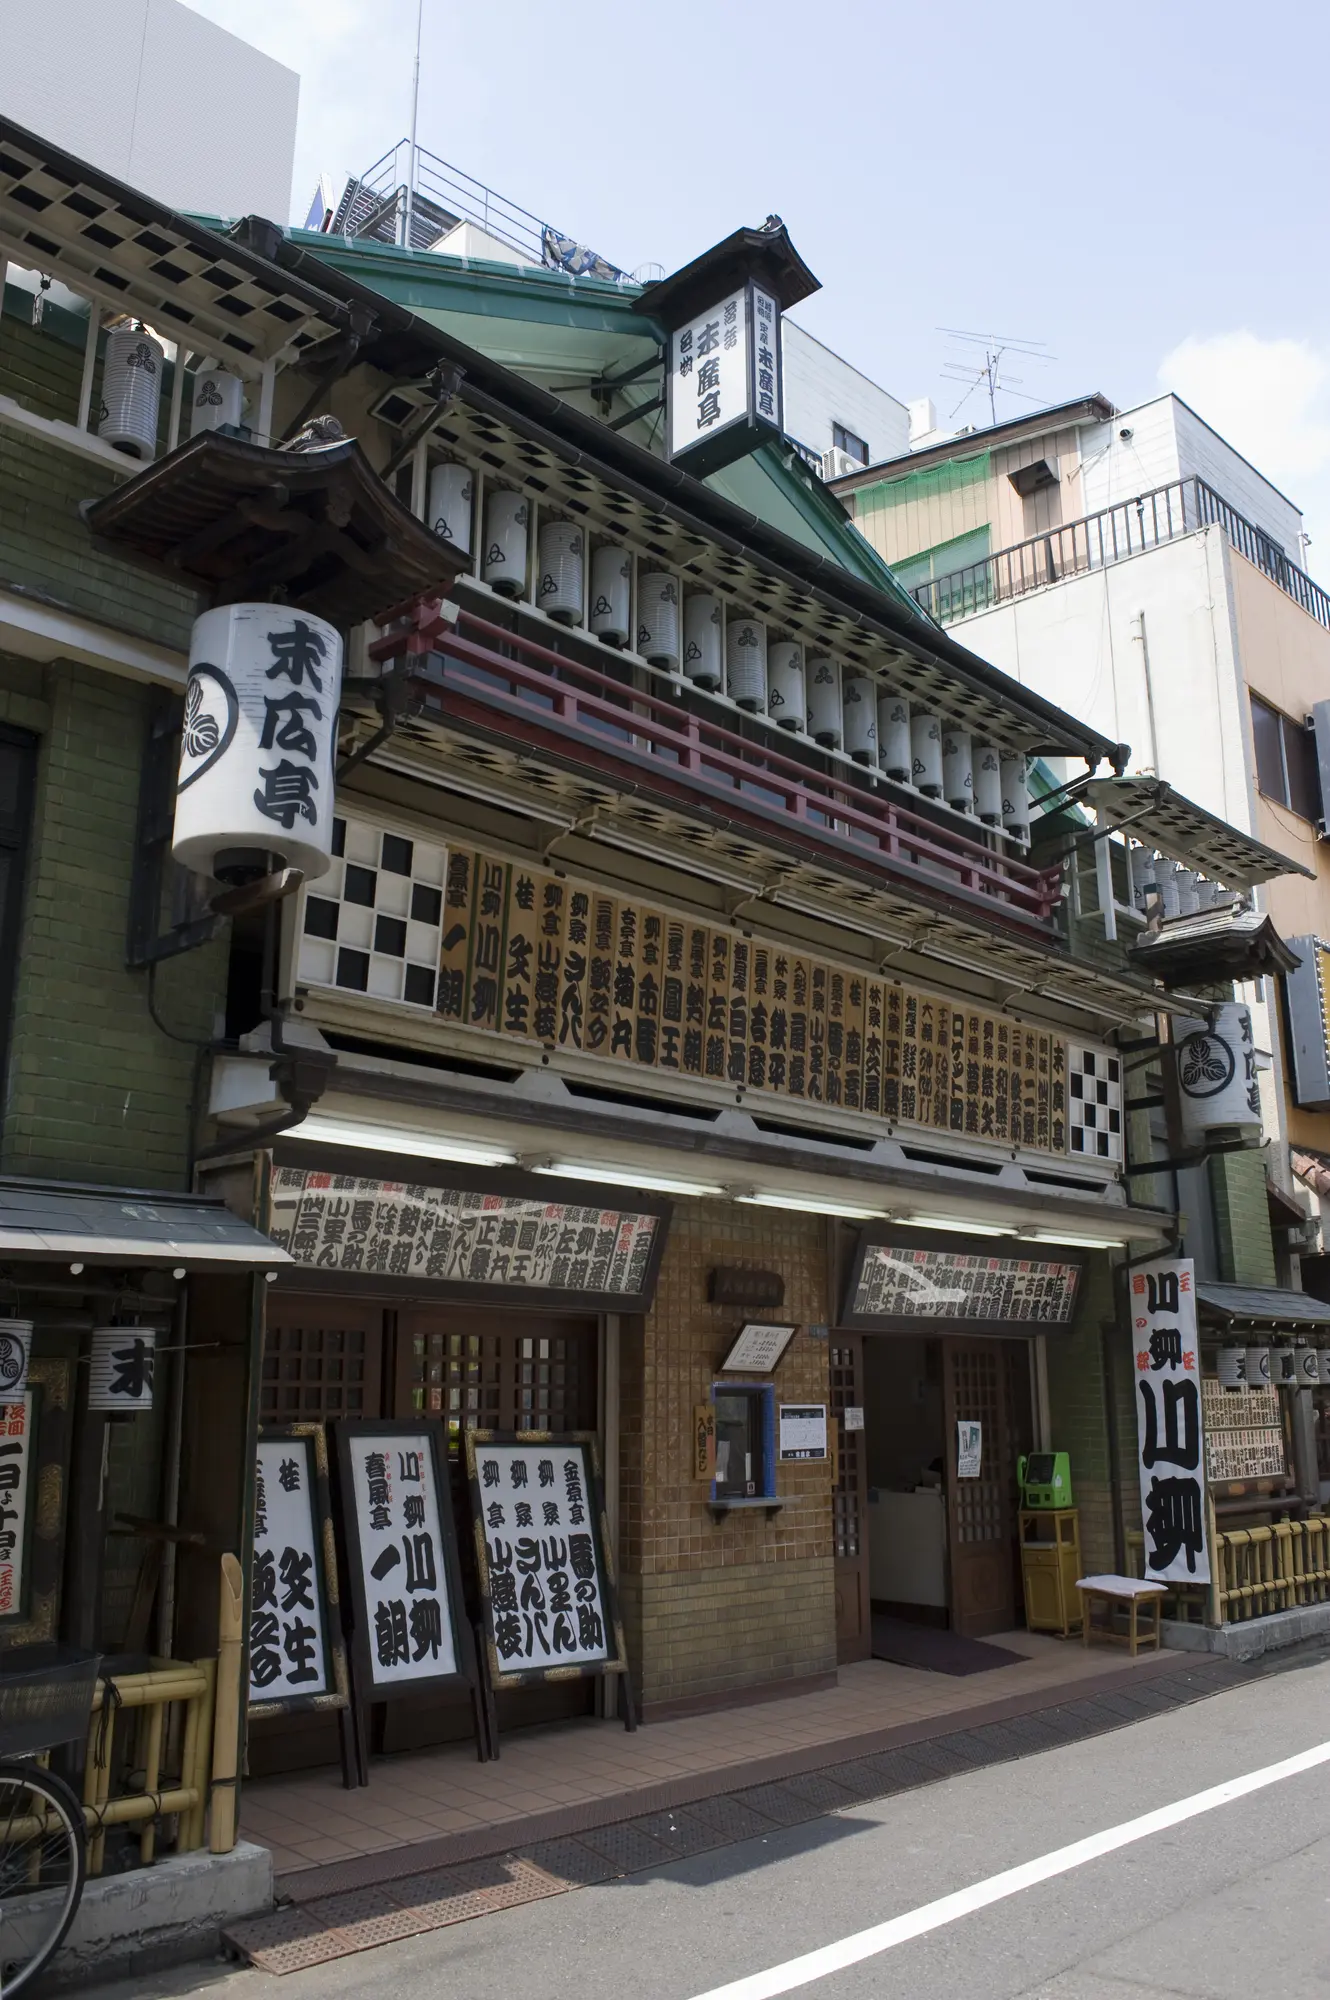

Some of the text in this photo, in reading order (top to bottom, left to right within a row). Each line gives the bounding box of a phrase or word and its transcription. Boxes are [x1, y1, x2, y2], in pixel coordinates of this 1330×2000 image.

[696, 321, 721, 430] 末廣亭
[758, 345, 774, 417] 末廣亭
[253, 619, 327, 830] 末広亭
[437, 852, 470, 1018] 春風亭一朝
[505, 873, 535, 1033] 桂文生
[636, 914, 660, 1063] 柳亭市馬
[949, 1012, 965, 1132] ロケット団
[317, 1196, 350, 1267] 小里ん
[341, 1199, 374, 1270] 馬の助
[109, 1338, 154, 1398] 末
[278, 1456, 319, 1686] 桂文生
[364, 1450, 410, 1668] 春風亭一朝
[397, 1450, 443, 1661] 川柳川柳
[538, 1459, 577, 1655] 柳家小里ん
[563, 1459, 604, 1651] 金原亭馬の助
